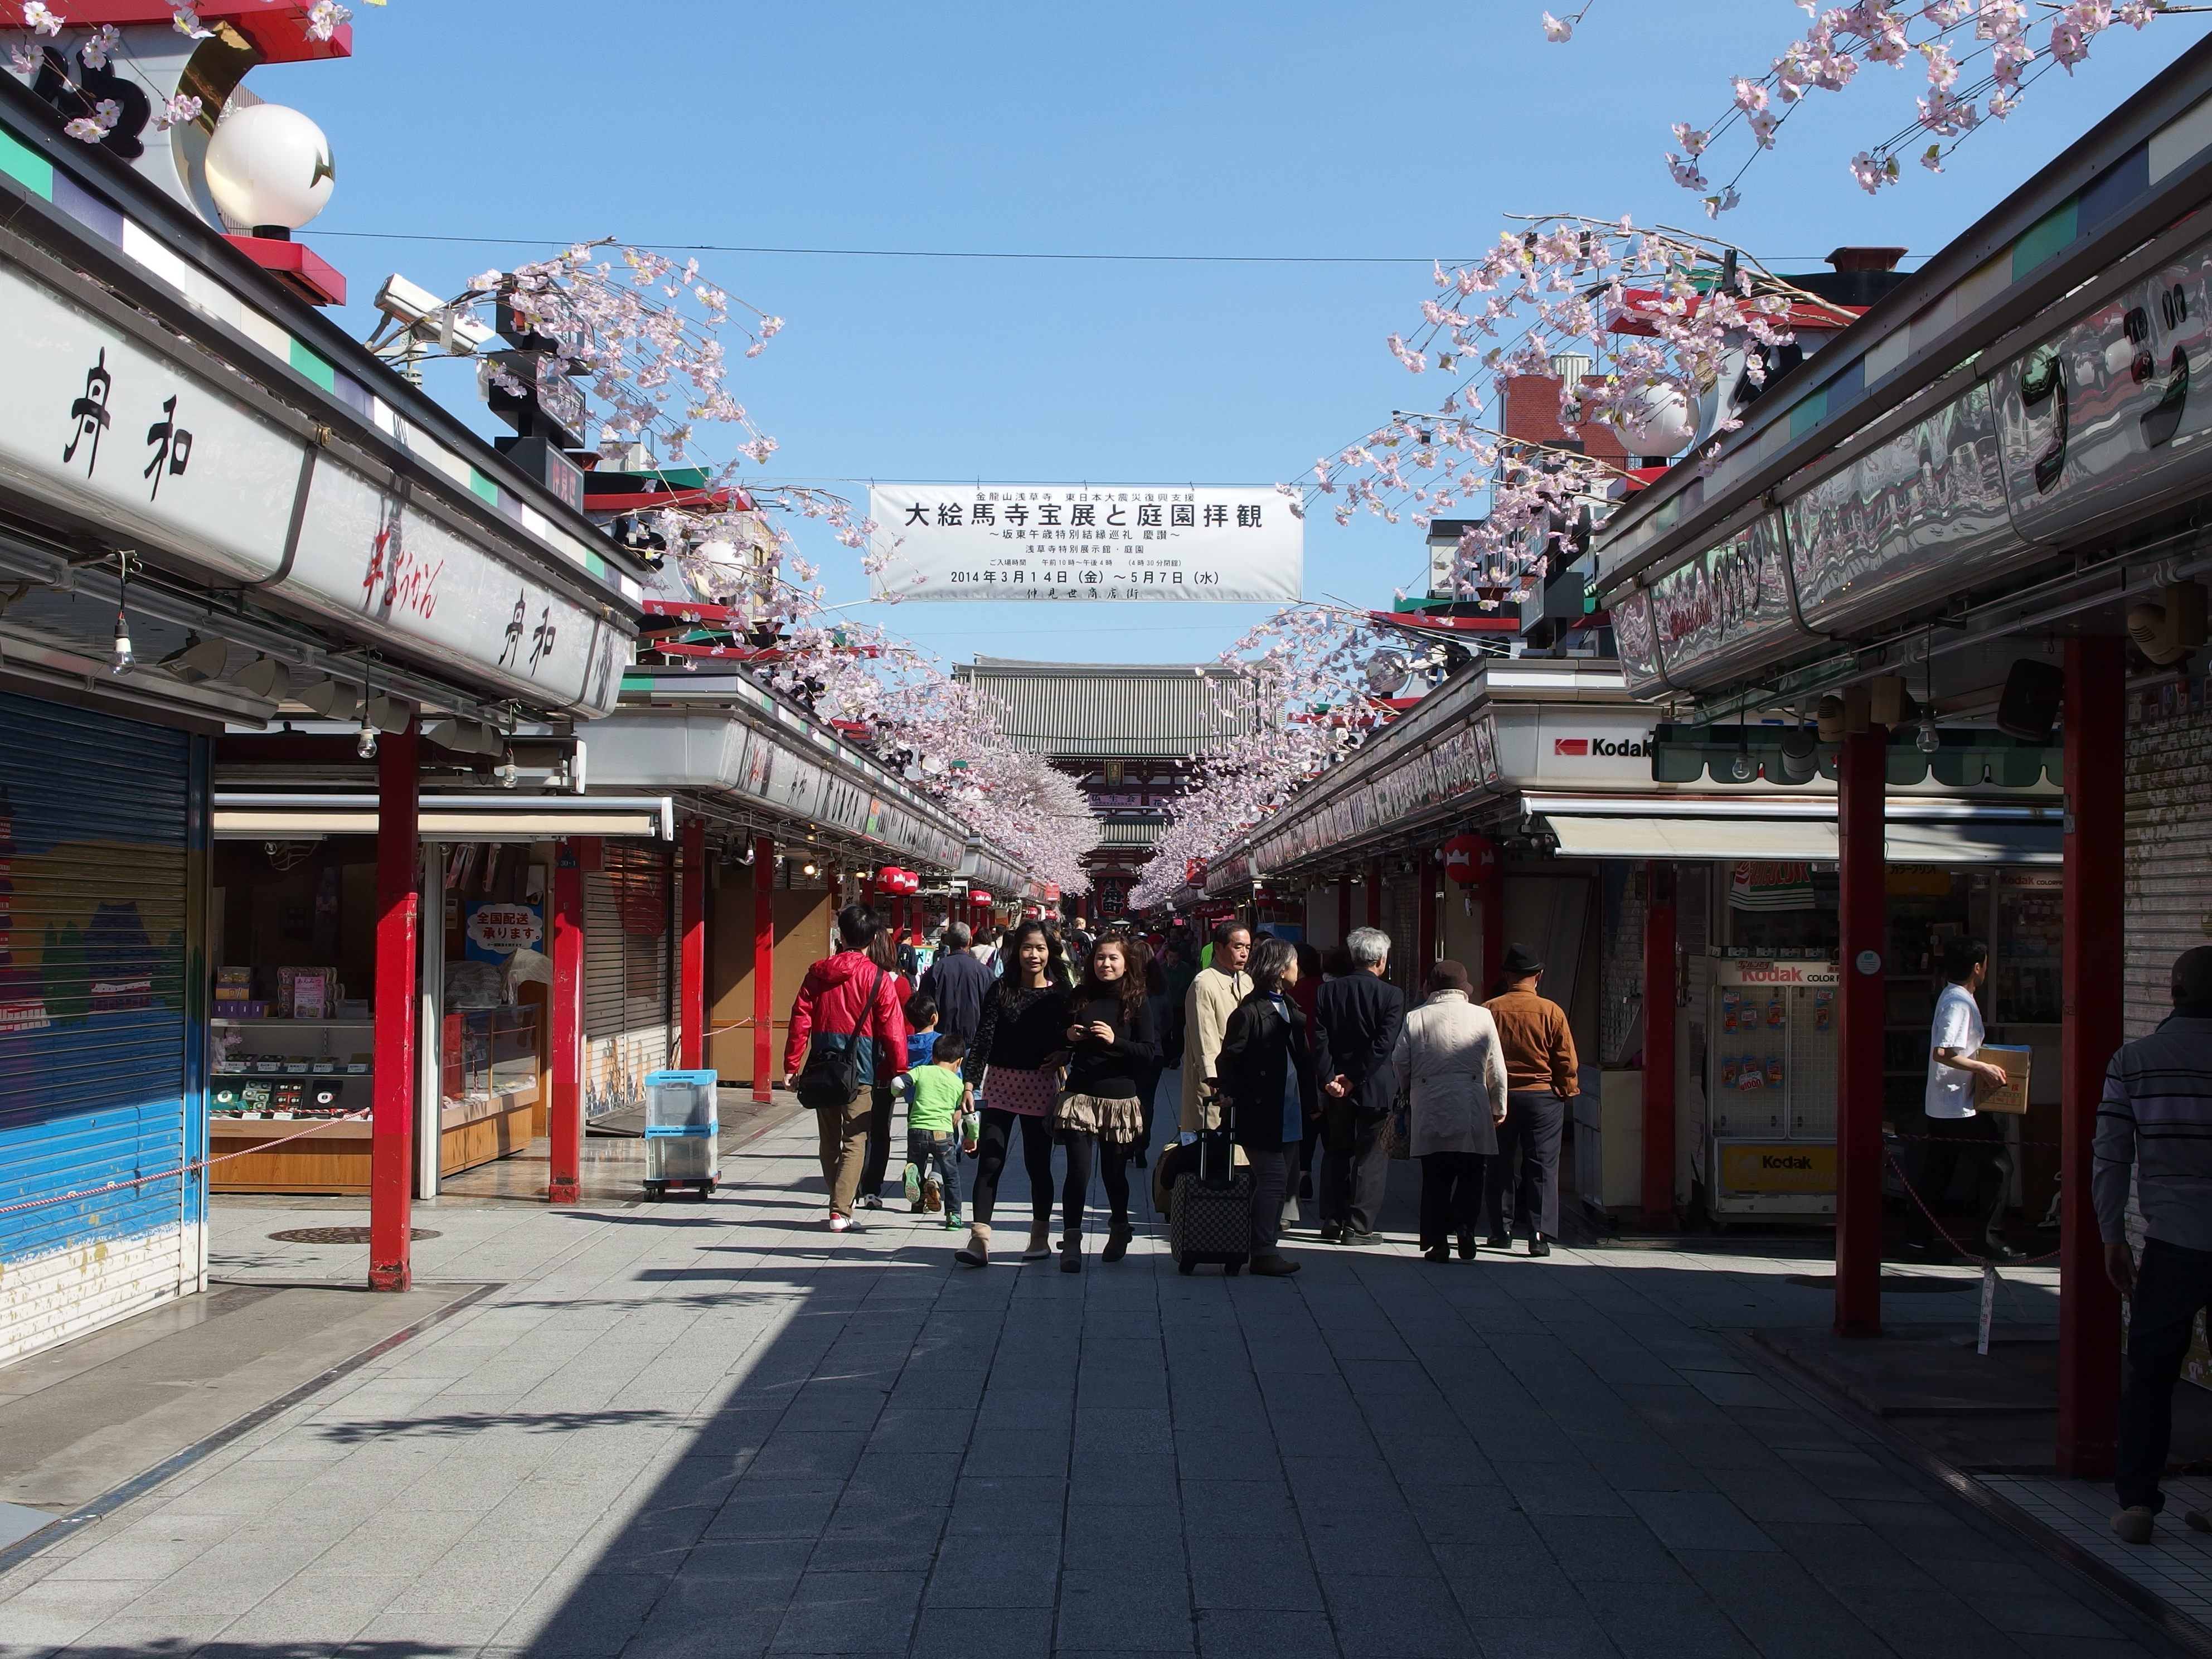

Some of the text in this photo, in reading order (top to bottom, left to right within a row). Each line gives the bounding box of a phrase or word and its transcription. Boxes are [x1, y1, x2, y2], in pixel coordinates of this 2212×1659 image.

[64, 346, 193, 502] 舟和
[976, 492, 1195, 502] 金龍山浅草寺 東日本大震災復興支援
[905, 502, 1263, 528] 大絵馬寺宝展と庭園拝観
[1025, 545, 1144, 554] 浅草寺特別展示館・庭園
[1026, 587, 1139, 601] 仲見世商店街
[498, 588, 556, 678] 舟和
[1593, 739, 1652, 757] Kodak
[2001, 876, 2035, 885] Kodak
[1101, 877, 1125, 915] 小舟町
[477, 911, 528, 925] 全国配送
[483, 927, 540, 940] 承ります。
[1737, 961, 1772, 970] 写ルンです
[1742, 966, 1803, 982] Kodak
[1763, 1155, 1812, 1170] Kodak
[1777, 1171, 1837, 1183] PRODUC
